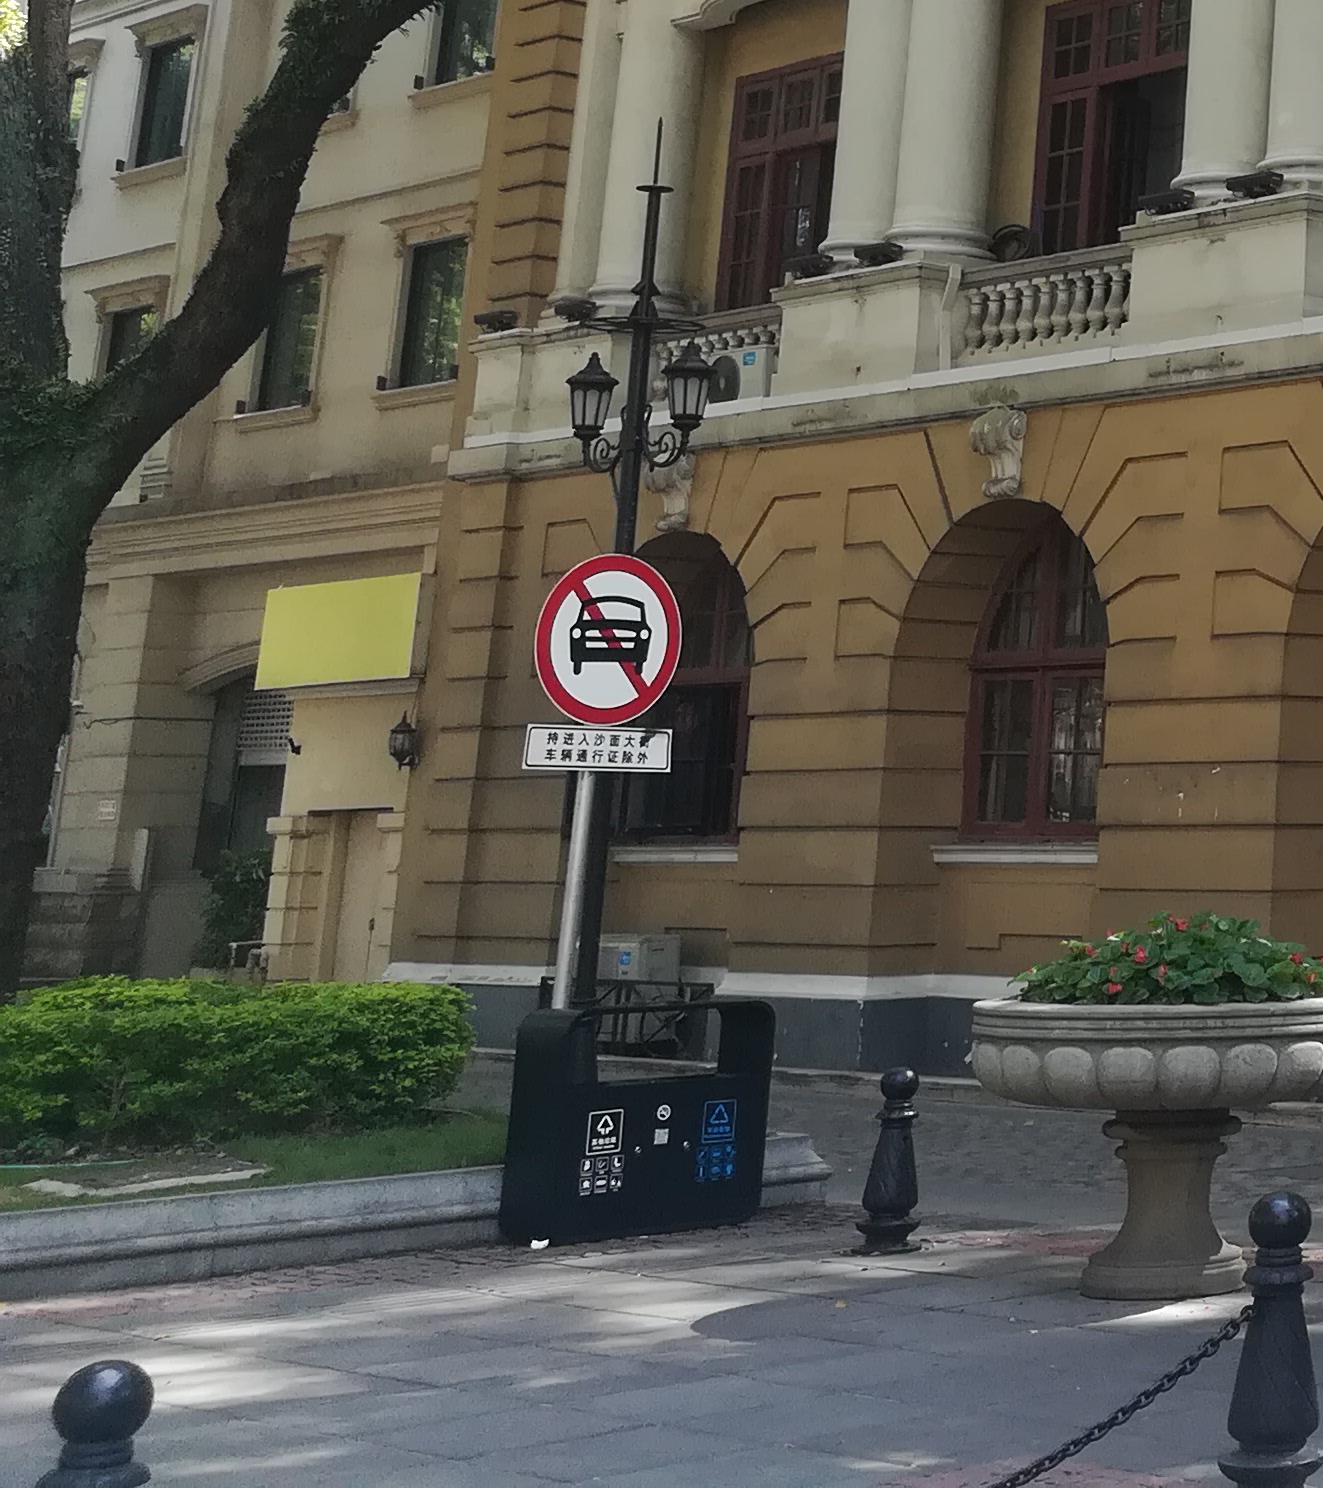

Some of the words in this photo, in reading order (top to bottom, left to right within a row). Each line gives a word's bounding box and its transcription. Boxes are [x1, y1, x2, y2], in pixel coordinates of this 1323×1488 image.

[544, 748, 649, 765] 车辆通行证除外
